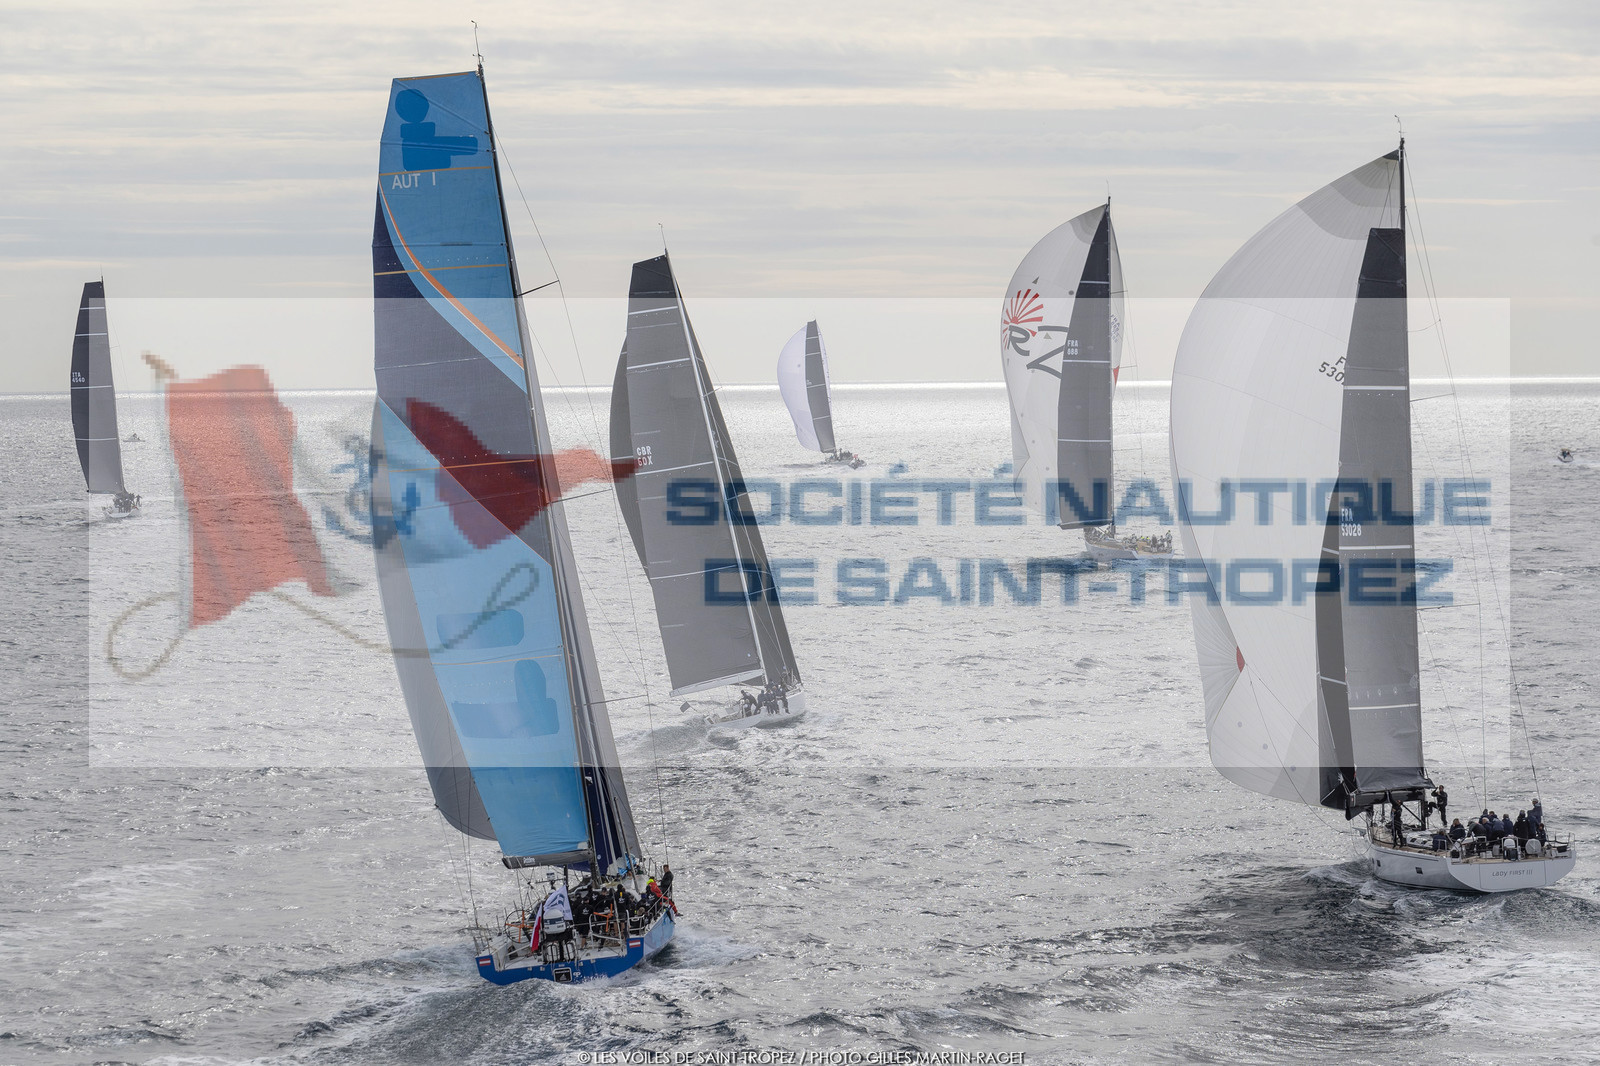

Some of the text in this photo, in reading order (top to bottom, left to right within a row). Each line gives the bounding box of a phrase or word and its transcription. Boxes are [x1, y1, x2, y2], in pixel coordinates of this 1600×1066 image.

[391, 172, 421, 190] AUT
[1067, 339, 1079, 347] FRA
[637, 455, 653, 467] 60X
[1341, 507, 1354, 522] FRA
[1341, 523, 1362, 537] 53028
